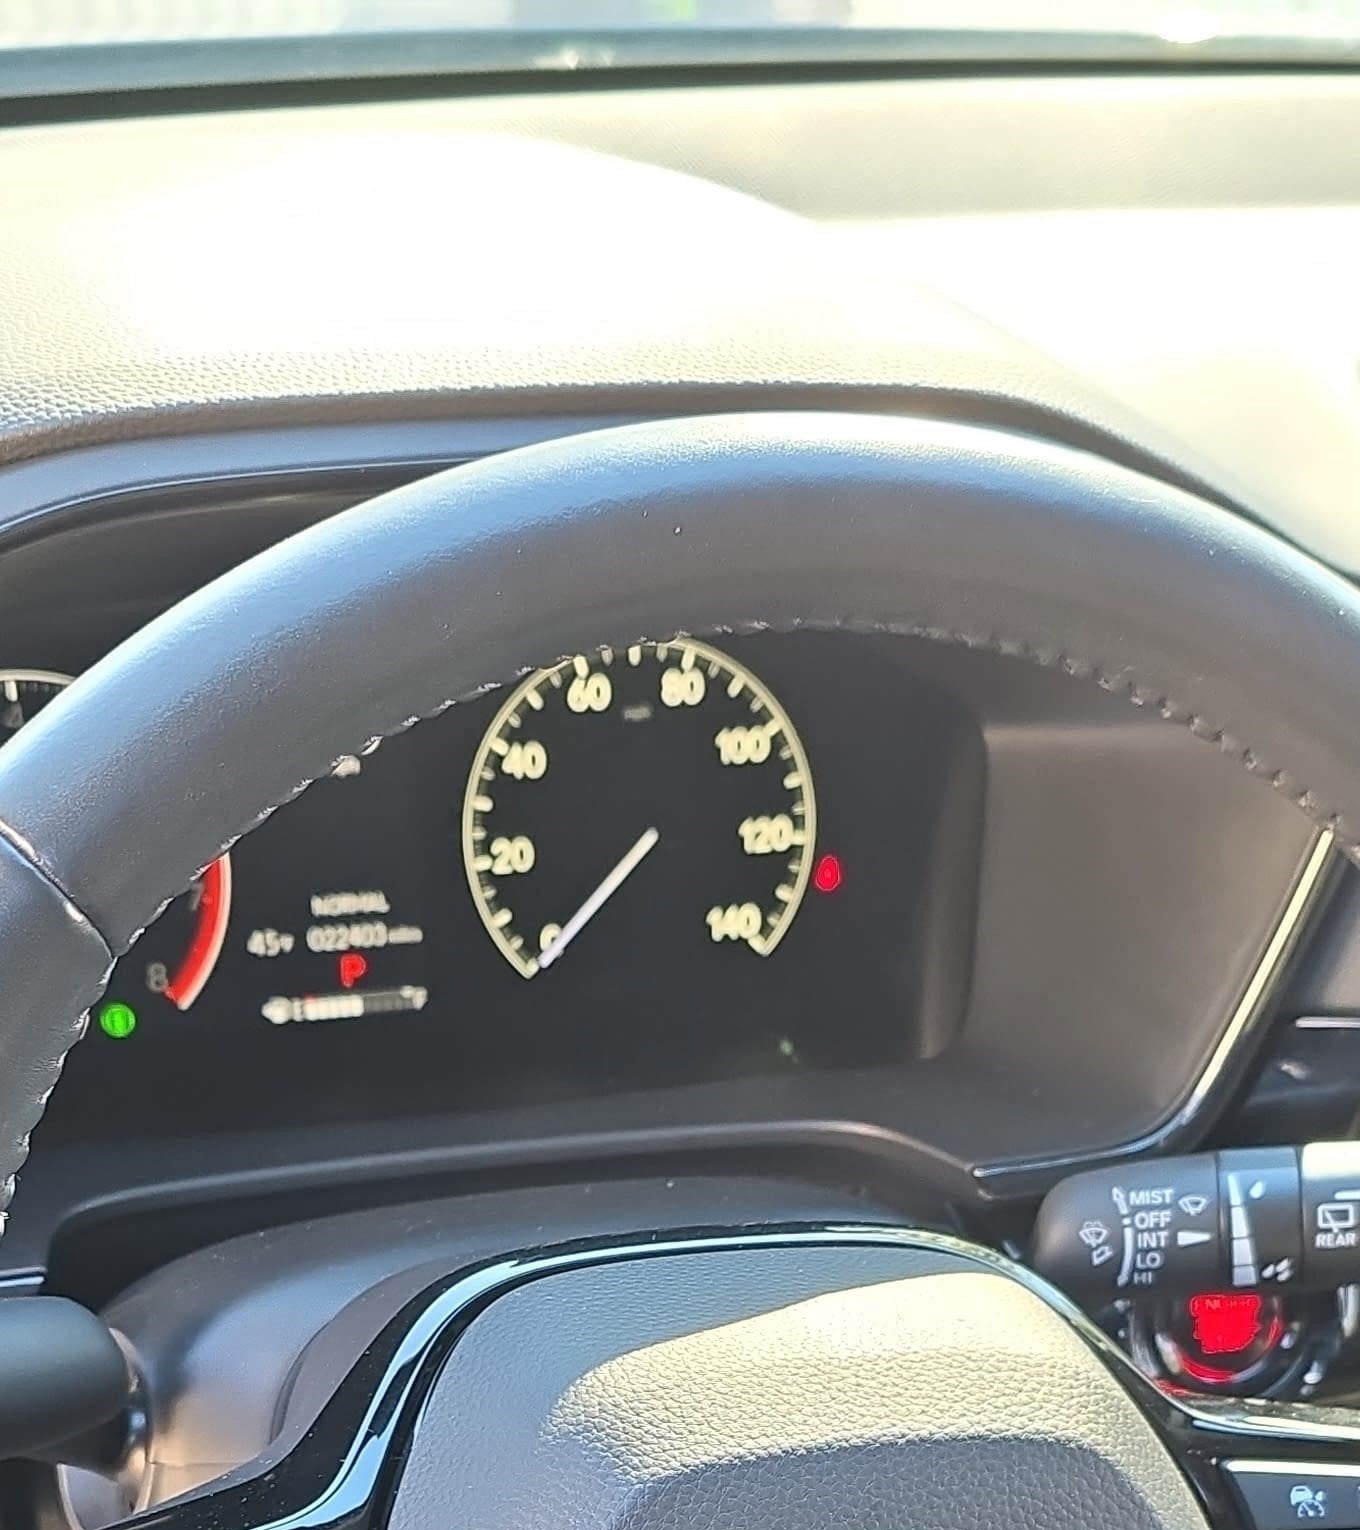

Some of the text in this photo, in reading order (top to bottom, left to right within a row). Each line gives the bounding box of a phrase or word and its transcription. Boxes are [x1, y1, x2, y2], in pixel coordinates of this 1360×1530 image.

[566, 672, 613, 712] 60
[660, 667, 706, 707] 80
[501, 741, 547, 780] 40
[715, 726, 771, 765] 100
[738, 813, 795, 855] 120
[489, 836, 536, 875] 20
[706, 902, 762, 942] 140
[146, 962, 168, 993] 8
[340, 953, 367, 987] P
[1129, 1188, 1174, 1206] MIST
[1134, 1210, 1171, 1230] OFF
[1137, 1231, 1169, 1249] INT
[1315, 1232, 1357, 1249] REAR
[1136, 1251, 1162, 1269] LO
[1133, 1271, 1153, 1285] HI
